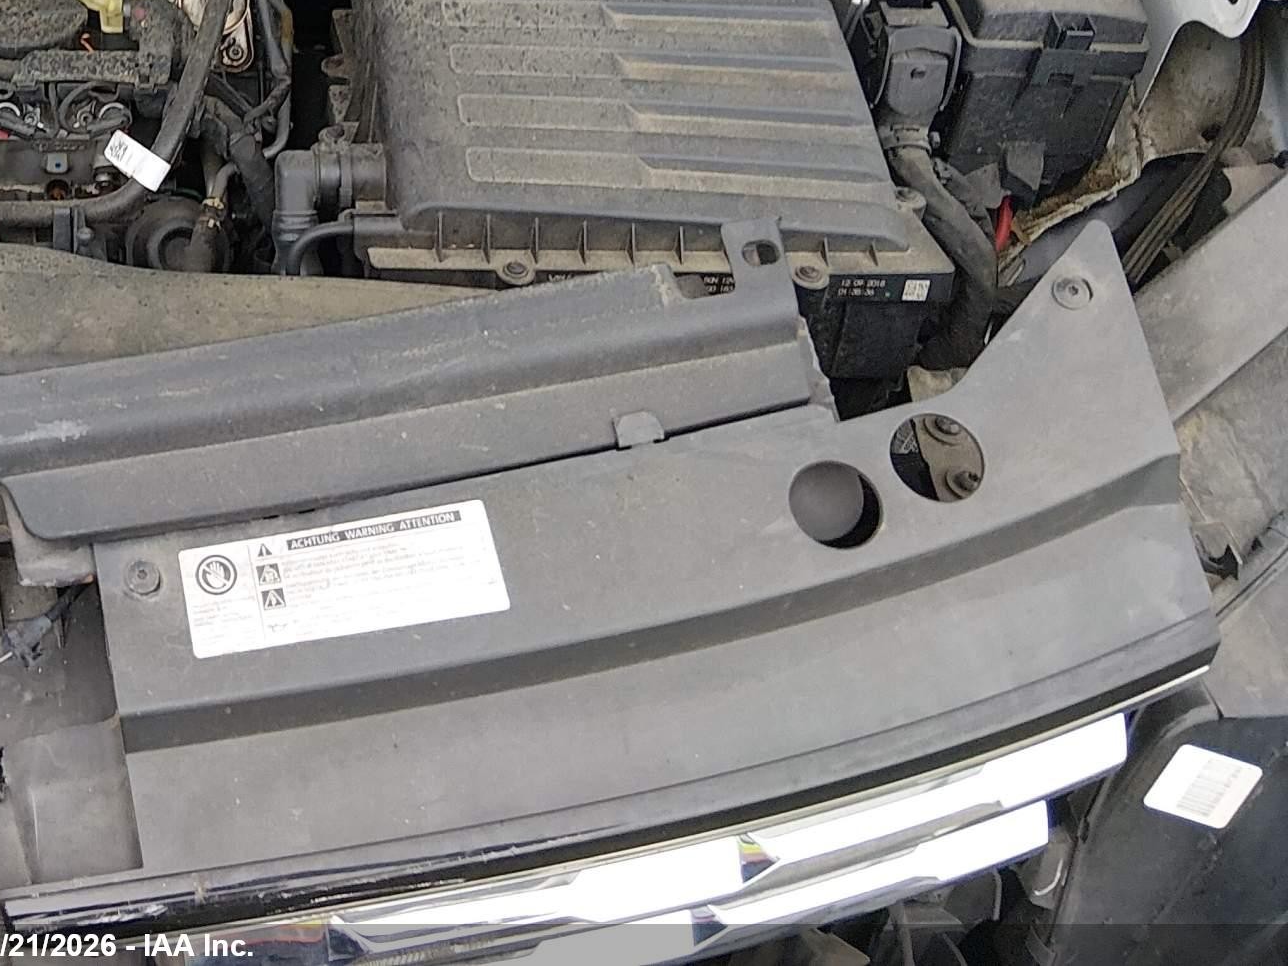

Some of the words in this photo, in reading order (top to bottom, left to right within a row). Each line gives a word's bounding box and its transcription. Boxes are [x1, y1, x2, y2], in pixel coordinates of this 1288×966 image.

[290, 532, 340, 550] ACHTUNG
[344, 522, 395, 540] WARNING
[399, 512, 456, 532] ATTENTION
